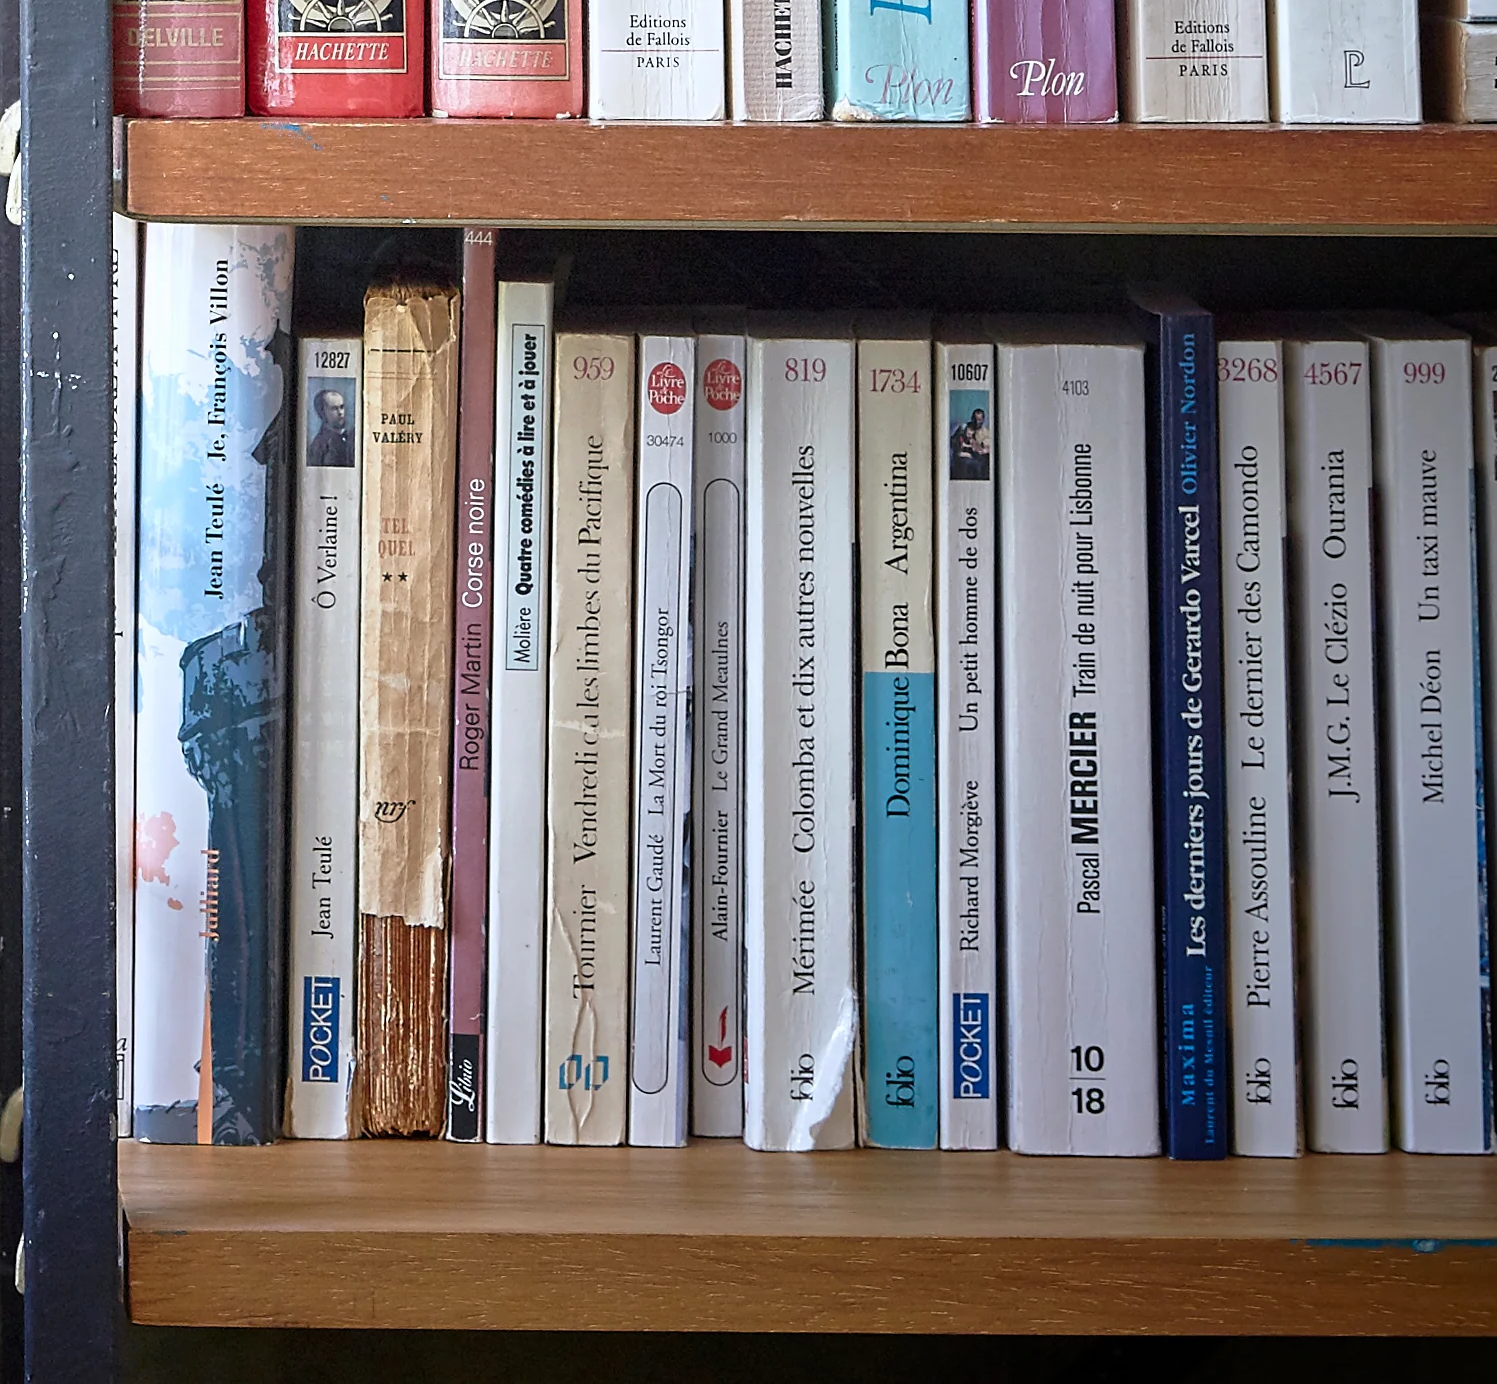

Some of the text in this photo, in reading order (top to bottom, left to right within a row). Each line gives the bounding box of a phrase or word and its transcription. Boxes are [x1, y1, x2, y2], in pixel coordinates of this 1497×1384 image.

[127, 29, 224, 48] DELVILLE
[294, 43, 389, 61] HACHETTE
[626, 32, 690, 47] de Fallois
[629, 15, 687, 29] Editions
[637, 56, 680, 68] PARIS
[1010, 59, 1085, 97] Plon
[314, 351, 350, 369] 12827
[573, 356, 614, 381] 959
[784, 358, 827, 383] 819
[870, 369, 922, 394] 1734
[951, 363, 988, 381] 10607
[1062, 380, 1089, 396] 4103
[1305, 362, 1362, 385] 4567
[1403, 362, 1445, 384] 999
[204, 258, 232, 600] Jean Teulé Je, François Villon
[372, 430, 423, 445] VALÉRY
[381, 413, 415, 425] PAUL
[647, 434, 684, 448] 30474
[708, 431, 737, 444] 1000
[1178, 332, 1197, 495] Olivier Nordon
[1069, 442, 1093, 527] Lisbonne
[1235, 444, 1261, 573] Camondo
[461, 477, 485, 609] Corse noire
[514, 460, 535, 662] Molière Quatre comédies
[576, 434, 609, 675] limbes du Pacifique
[792, 444, 816, 647] autres nouvelles
[1321, 448, 1350, 670] Clézio Ourania
[1178, 504, 1203, 695] Gerardo Varcel
[1418, 449, 1441, 714] Déon Un taxi mauve
[650, 607, 674, 708] roi Tsongor
[884, 451, 916, 818] Dominique Bona Argentina
[712, 621, 728, 764] Grand Meaulnes
[574, 751, 598, 865] Vendredi
[791, 735, 816, 854] Colomba
[1069, 711, 1098, 845] MERCIER
[711, 809, 729, 941] Alain-Fournier
[1243, 795, 1269, 924] Assouline
[792, 879, 816, 996] Mérimée
[309, 977, 334, 1082] POCKET
[1071, 1045, 1105, 1073] 10
[886, 1054, 915, 1109] folio
[1071, 1087, 1105, 1115] 18
